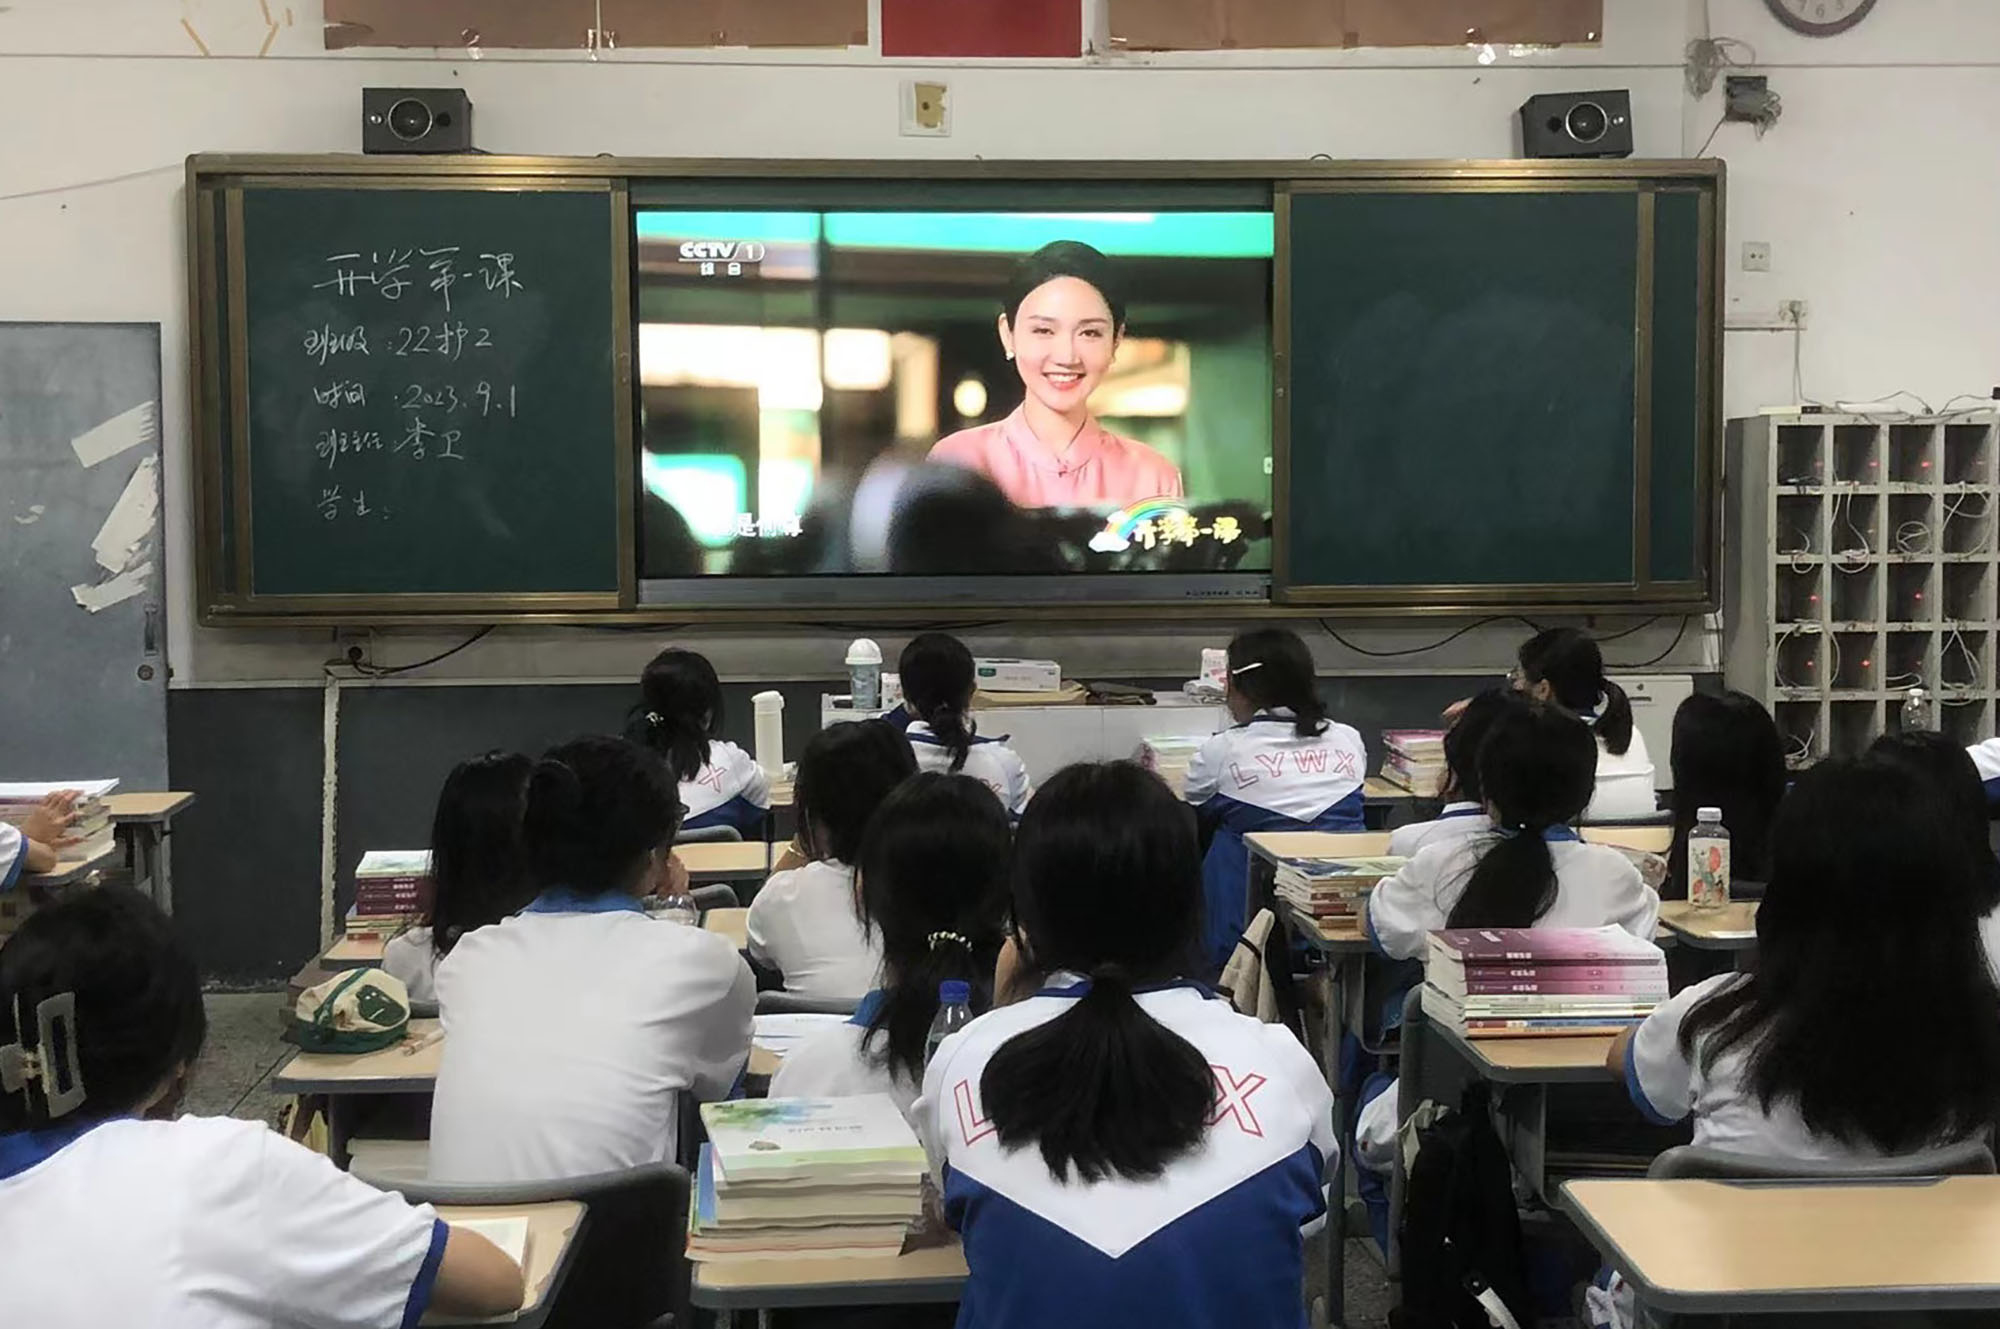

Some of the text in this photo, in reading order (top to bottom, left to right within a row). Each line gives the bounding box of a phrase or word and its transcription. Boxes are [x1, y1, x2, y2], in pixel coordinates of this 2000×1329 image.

[679, 241, 736, 259] CCTV
[312, 247, 524, 312] 开学第一课
[1229, 749, 1357, 790] LYWX
